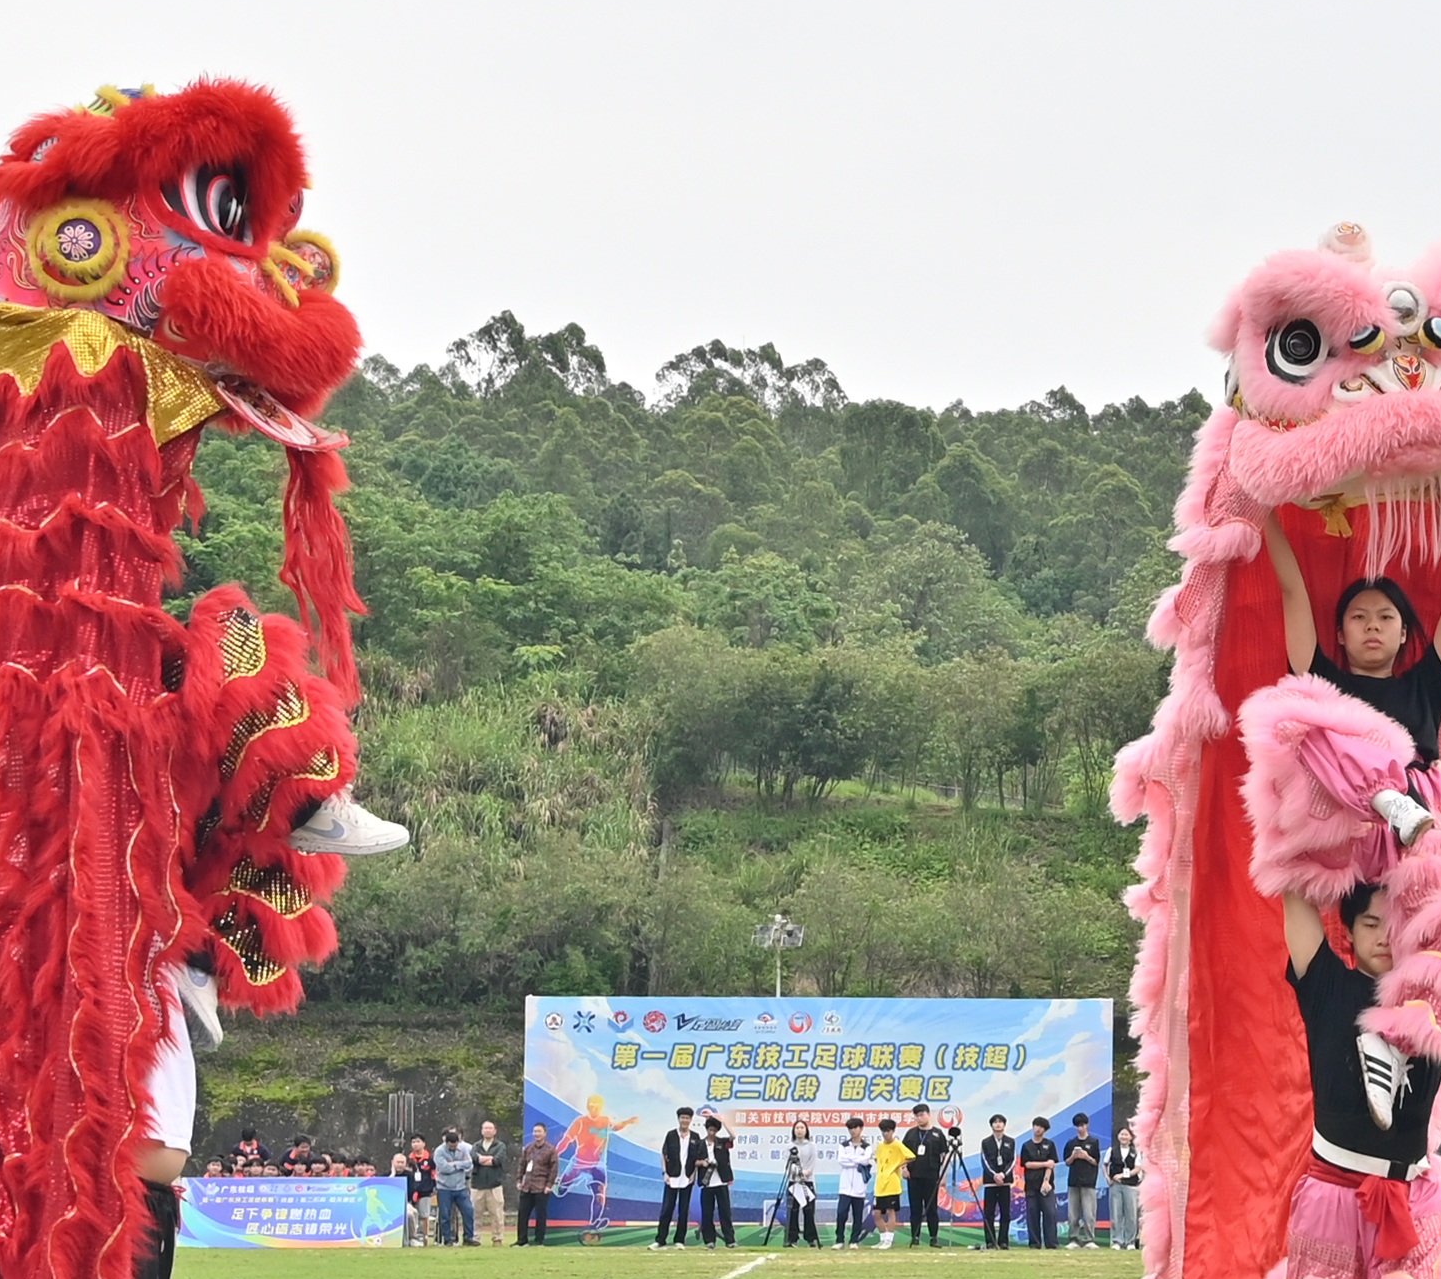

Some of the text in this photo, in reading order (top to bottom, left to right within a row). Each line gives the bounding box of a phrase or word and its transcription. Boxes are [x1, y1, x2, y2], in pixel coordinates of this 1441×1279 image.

[611, 1041, 1028, 1071] 第一届广东技工足球联赛（技超）
[706, 1074, 953, 1102] 第二阶段 韶关赛区
[734, 1111, 916, 1124] 韶关市技师学院VS惠州市技师学
